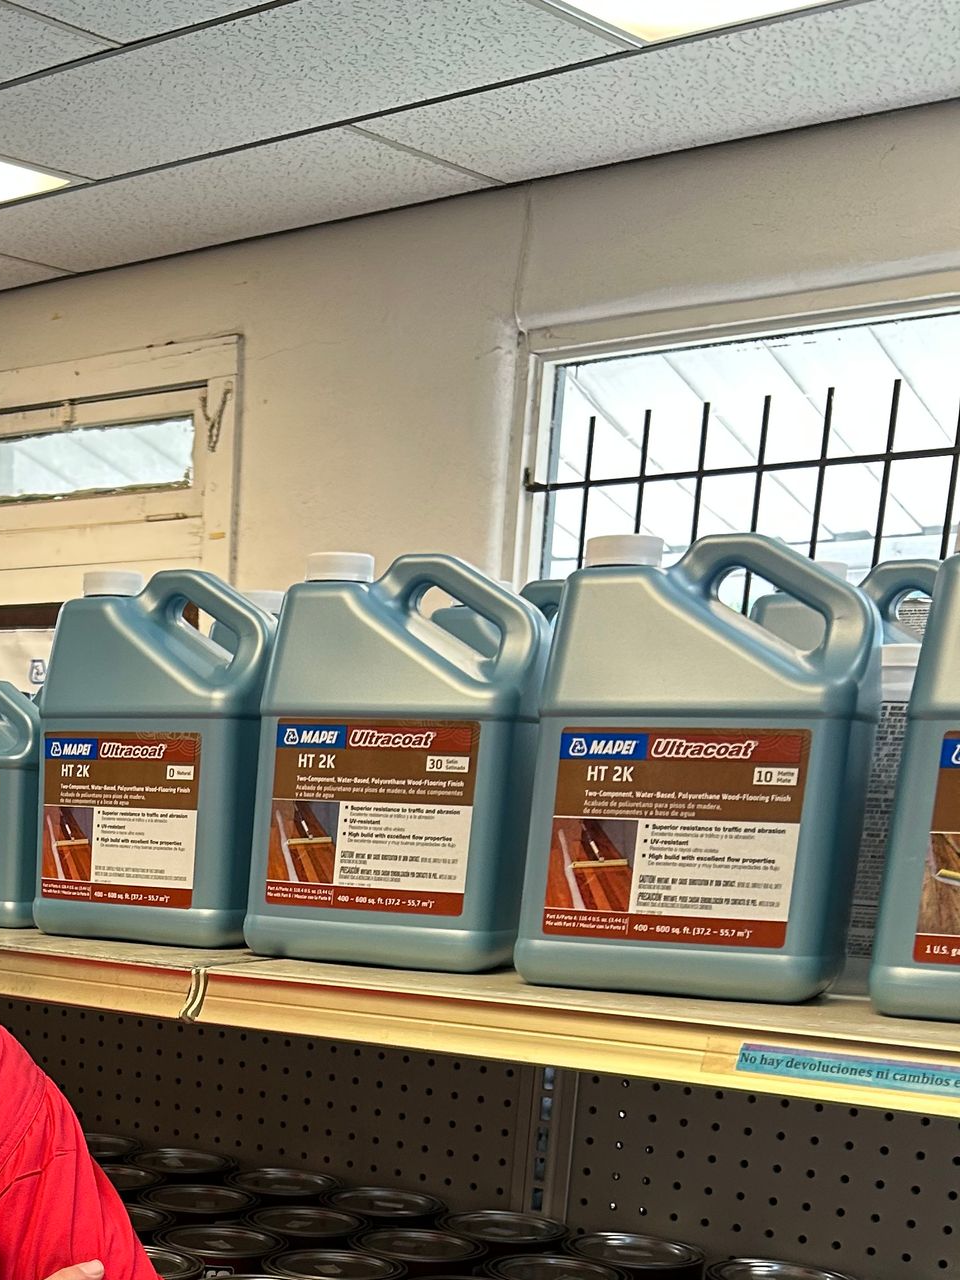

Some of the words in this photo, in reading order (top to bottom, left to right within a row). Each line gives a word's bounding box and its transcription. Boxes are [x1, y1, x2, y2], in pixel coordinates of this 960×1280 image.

[300, 730, 338, 744] MAPEI
[349, 729, 434, 748] Ultracoat
[63, 743, 91, 756] MAPEI
[100, 742, 165, 759] Ultracoat
[590, 739, 637, 755] MAPEI
[651, 739, 755, 759] Ultracoat
[298, 754, 315, 768] HT
[319, 755, 335, 769] 2K
[429, 759, 443, 769] 30
[61, 764, 73, 777] HT
[76, 765, 90, 778] 2K
[587, 766, 608, 782] HT
[612, 766, 634, 782] 2K
[756, 771, 773, 783] 10
[584, 789, 634, 798] Two-Component,
[678, 792, 720, 802] Polyurethane
[721, 793, 769, 802] Wood-Flooring
[652, 823, 678, 832] Superior
[682, 854, 694, 862] with
[742, 857, 776, 865] properties
[633, 924, 648, 932] 400
[926, 945, 931, 953] 1
[740, 1052, 757, 1064] No
[759, 1054, 784, 1070] hay
[785, 1057, 873, 1078] devoluciones
[876, 1070, 890, 1080] ni
[892, 1071, 950, 1087] cambios
